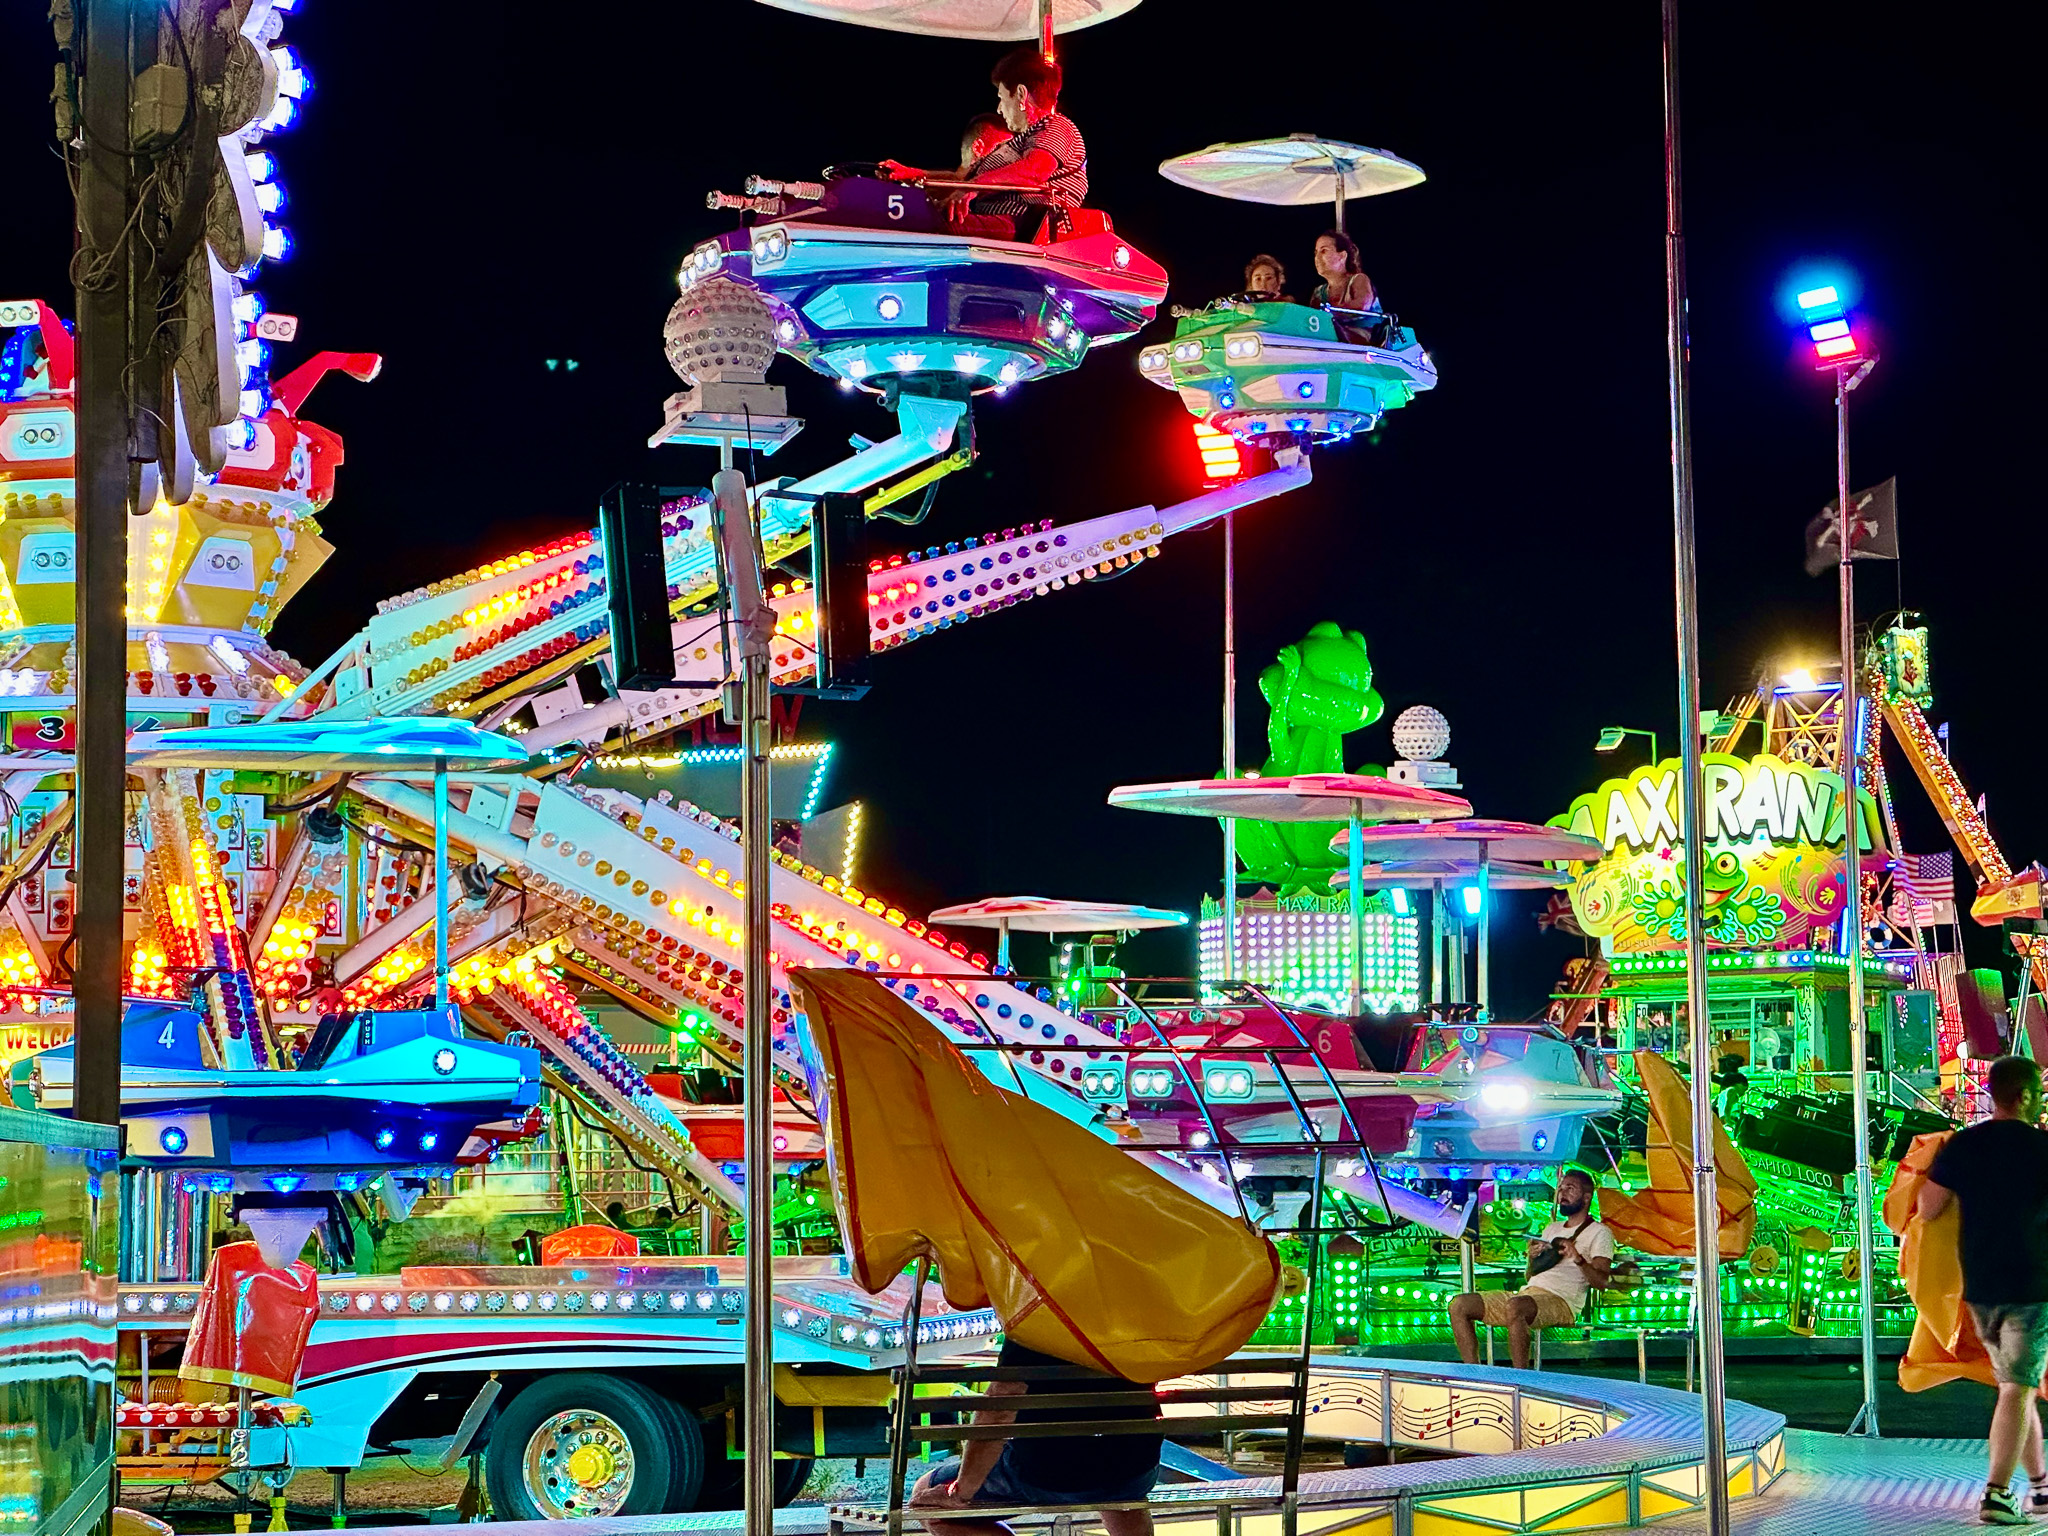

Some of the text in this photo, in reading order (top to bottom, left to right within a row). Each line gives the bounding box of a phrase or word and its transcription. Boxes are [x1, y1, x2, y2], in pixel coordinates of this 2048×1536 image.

[888, 195, 904, 220] 5
[1309, 315, 1320, 332] 9
[36, 716, 65, 742] 3
[1704, 764, 1872, 854] RANA
[1276, 896, 1376, 913] MAXI RAA
[5, 1026, 74, 1049] WELCO
[158, 1020, 176, 1049] 4
[1318, 1030, 1332, 1053] 6
[1552, 1048, 1562, 1070] 7
[1748, 1153, 1833, 1188] SAPITO LOCO
